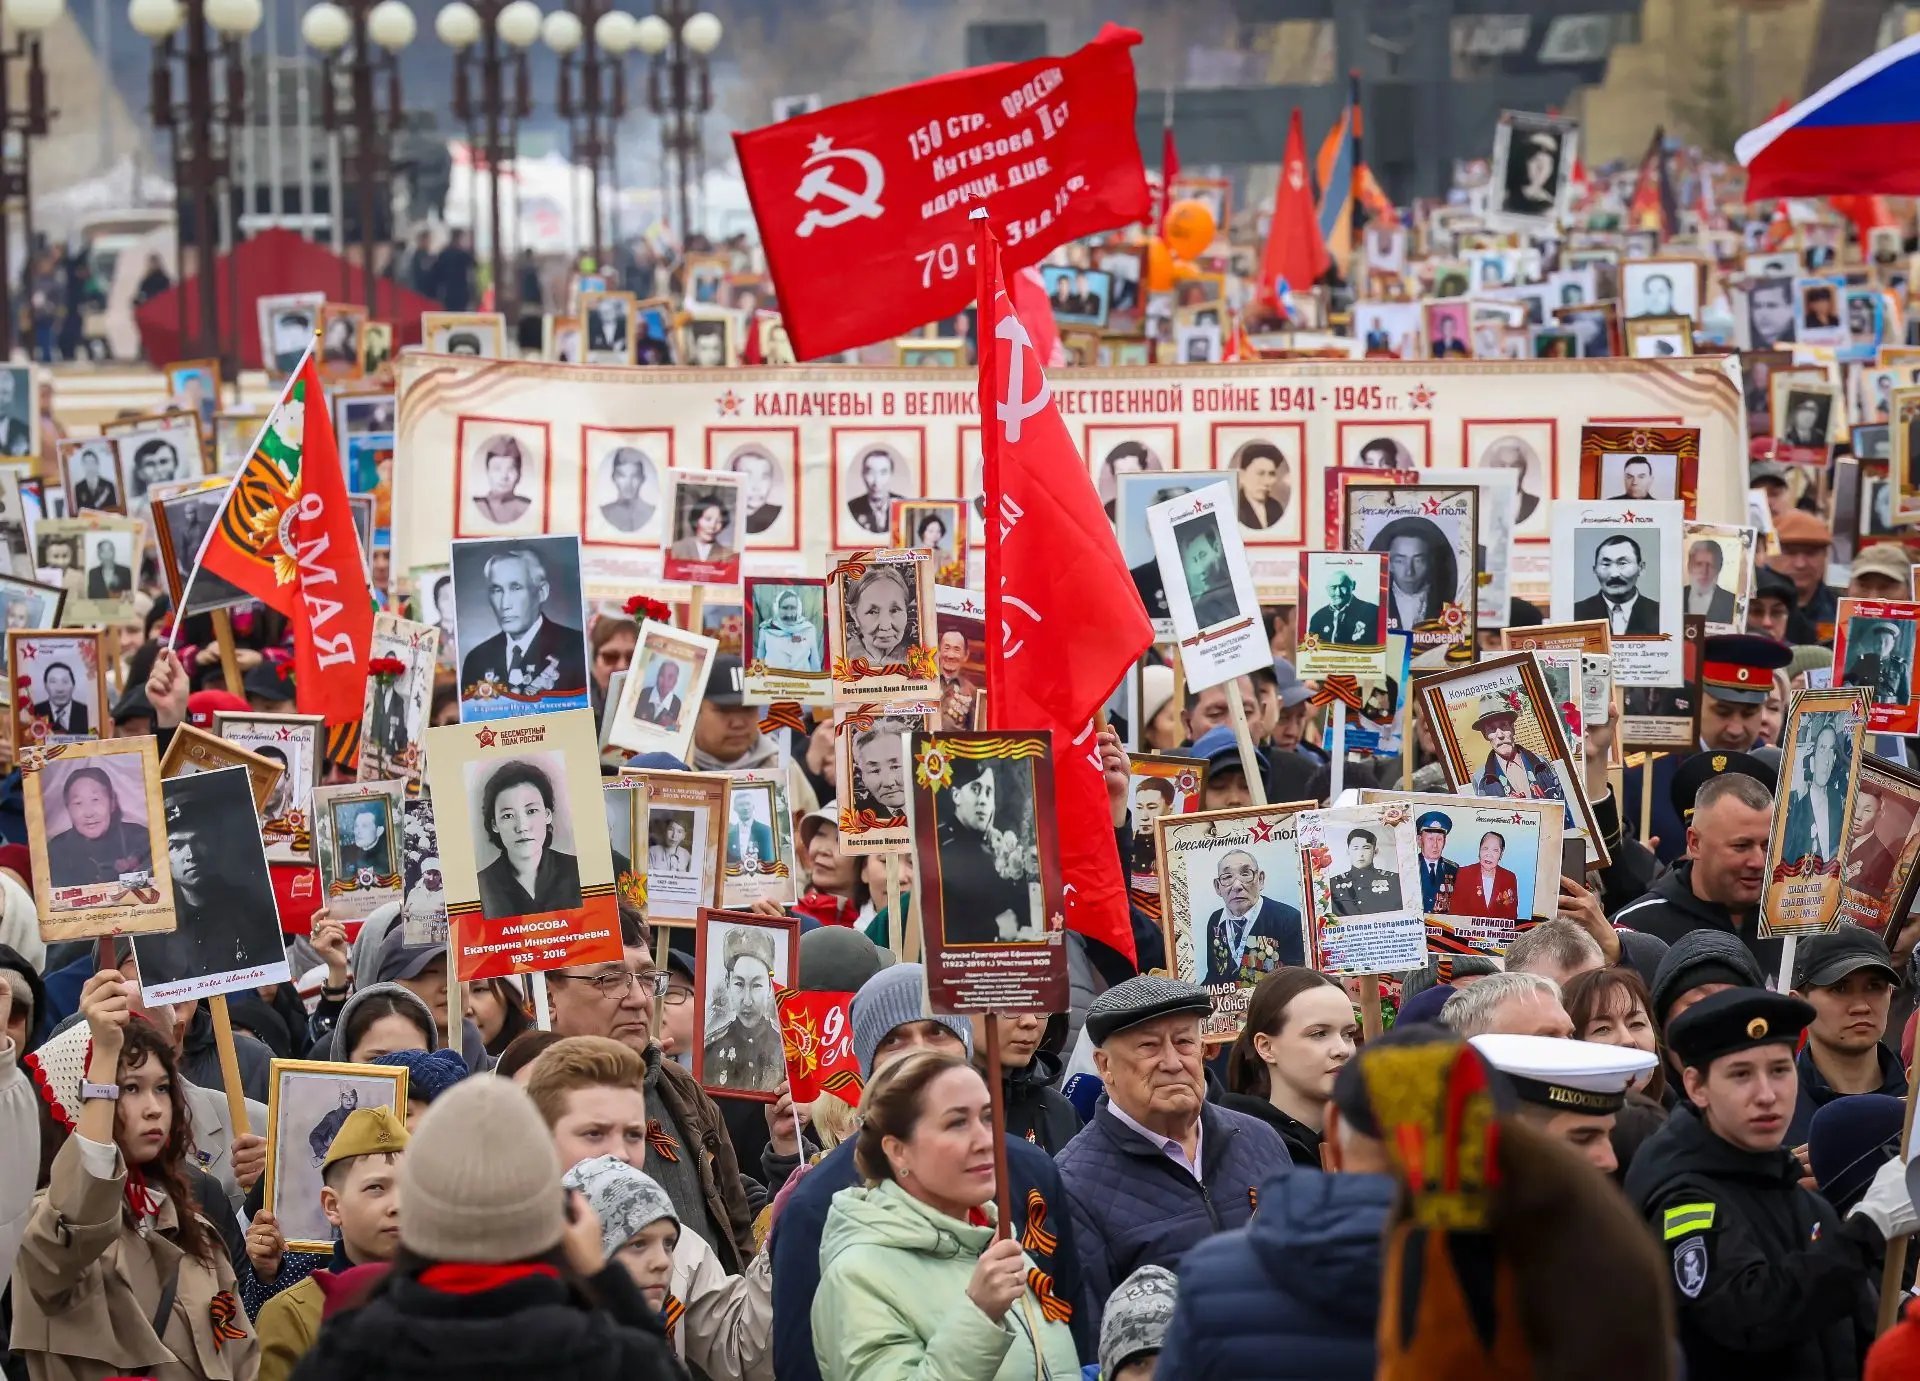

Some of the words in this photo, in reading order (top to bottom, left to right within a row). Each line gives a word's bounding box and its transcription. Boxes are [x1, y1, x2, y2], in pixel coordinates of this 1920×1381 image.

[908, 119, 943, 160] 150
[755, 392, 872, 416] КАЛАЧЕВЫ
[883, 392, 894, 415] В
[905, 391, 979, 415] ВЕЛИК
[1053, 384, 1182, 413] ЧЕСТВЕННОЙ
[1193, 384, 1260, 411] ВОЙНЕ
[1270, 387, 1315, 411] 1941
[1335, 386, 1381, 410] 1945
[298, 493, 324, 521] 9
[297, 531, 357, 672] МАЯ
[1412, 632, 1465, 644] иколаевич
[883, 685, 900, 694] Анна
[1448, 681, 1498, 700] Кондратьев
[1498, 674, 1518, 688] А.Н.
[500, 725, 546, 739] БЕССМЕРТНЫЙ
[501, 738, 518, 747] ПОЛК
[519, 734, 544, 745] РОССИИ
[884, 837, 910, 845] Никола
[1273, 830, 1298, 842] пол
[501, 919, 569, 936] АММОСОВА
[1321, 926, 1345, 935] Егоров
[1346, 923, 1372, 932] Степан
[1471, 917, 1515, 929] КОРНИЛОВА
[1454, 927, 1486, 938] Татьяна
[1486, 929, 1521, 940] Никонов
[463, 941, 522, 956] Екатерина
[524, 929, 610, 948] Иннокентьевна
[511, 952, 534, 964] 1935
[543, 948, 567, 960] 2016
[971, 951, 1010, 959] Григорий
[1216, 997, 1249, 1012] Конст
[820, 1005, 845, 1047] 9
